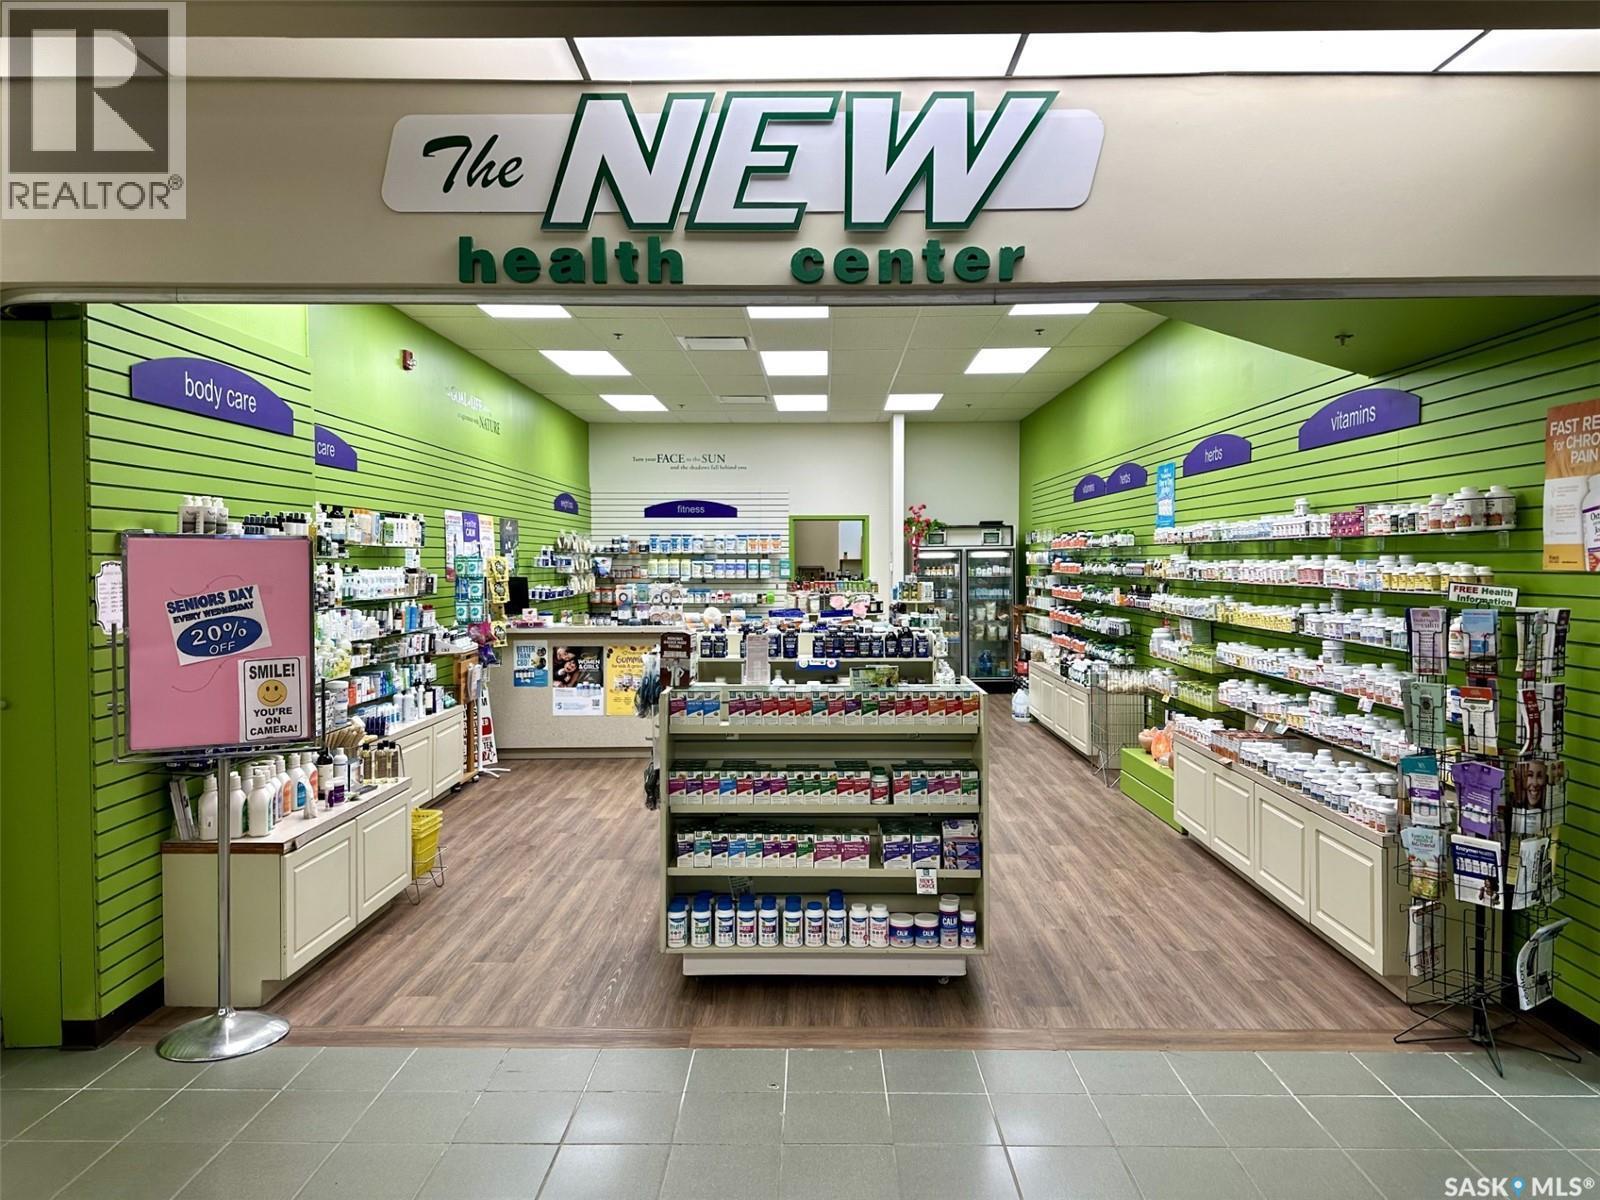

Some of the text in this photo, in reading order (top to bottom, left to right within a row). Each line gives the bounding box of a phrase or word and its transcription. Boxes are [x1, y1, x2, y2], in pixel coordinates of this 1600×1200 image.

[422, 90, 1059, 233] The NEW
[457, 235, 1026, 285] health center
[185, 371, 257, 413] body care
[479, 416, 500, 435] NATURE
[1331, 405, 1376, 431] vitamins
[1550, 418, 1579, 437] FAST
[317, 441, 335, 457] care
[1553, 440, 1565, 451] for
[656, 454, 685, 463] FACE
[702, 454, 726, 463] SUN
[1204, 447, 1223, 462] herbs
[1570, 449, 1598, 465] PAIN
[677, 505, 705, 513] fitness
[1453, 585, 1513, 597] FREE Health
[167, 586, 254, 614] SENIORS DAY
[1457, 594, 1513, 606] Information
[173, 601, 254, 624] EVERY WEDNESDAY
[190, 621, 247, 646] 20%
[209, 641, 236, 655] OFF
[249, 663, 295, 680] SMILE!
[253, 707, 292, 718] YOU'RE
[265, 716, 281, 725] ON
[250, 725, 298, 736] CAMERA!
